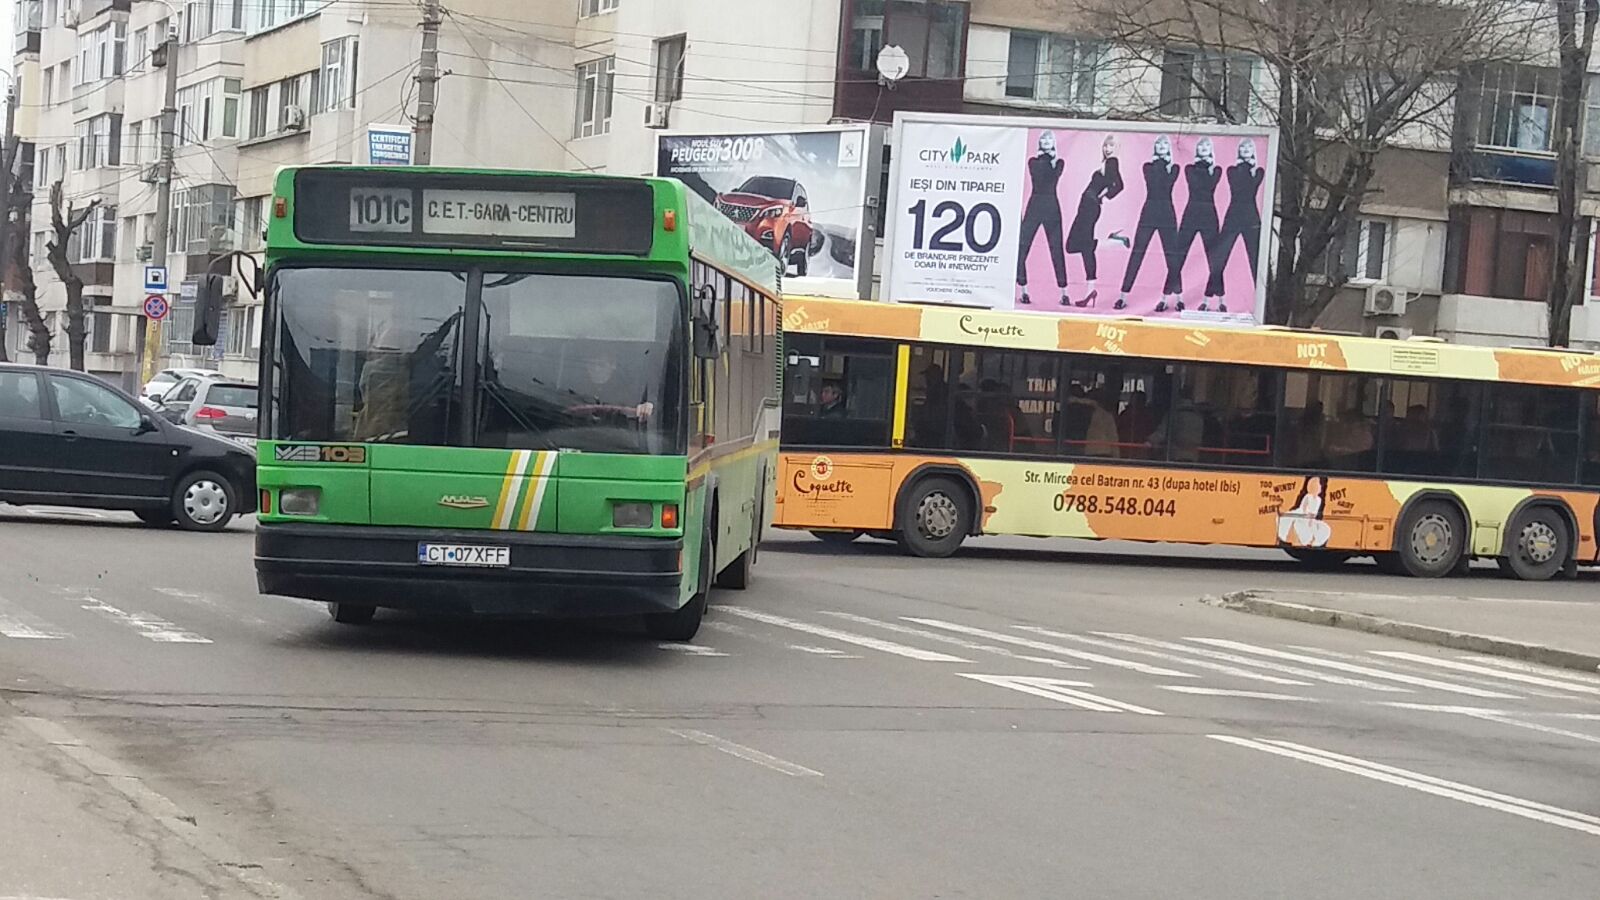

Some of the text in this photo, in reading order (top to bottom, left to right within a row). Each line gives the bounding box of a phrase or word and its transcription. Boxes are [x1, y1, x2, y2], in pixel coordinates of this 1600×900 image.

[670, 137, 764, 162] PEUGEOT 3008
[919, 149, 1000, 165] CITY PARK
[935, 179, 957, 191] DIN
[959, 180, 1006, 193] TIPARE!
[353, 194, 410, 225] 101C
[908, 199, 1002, 254] 120
[904, 251, 1000, 264] DE BRANDURI PREZENTE
[914, 260, 938, 269] DOAR
[959, 314, 1026, 342] Coquette
[1096, 323, 1128, 342] NOT
[1297, 343, 1328, 359] NOT
[793, 469, 854, 503] Coquette
[1024, 470, 1241, 495] Str. Mircea cel Batran nr. 43 (dupa hotel Ibis)
[1260, 480, 1273, 489] TOO
[1329, 487, 1347, 502] NOT
[1053, 493, 1176, 517] 0788.548.044
